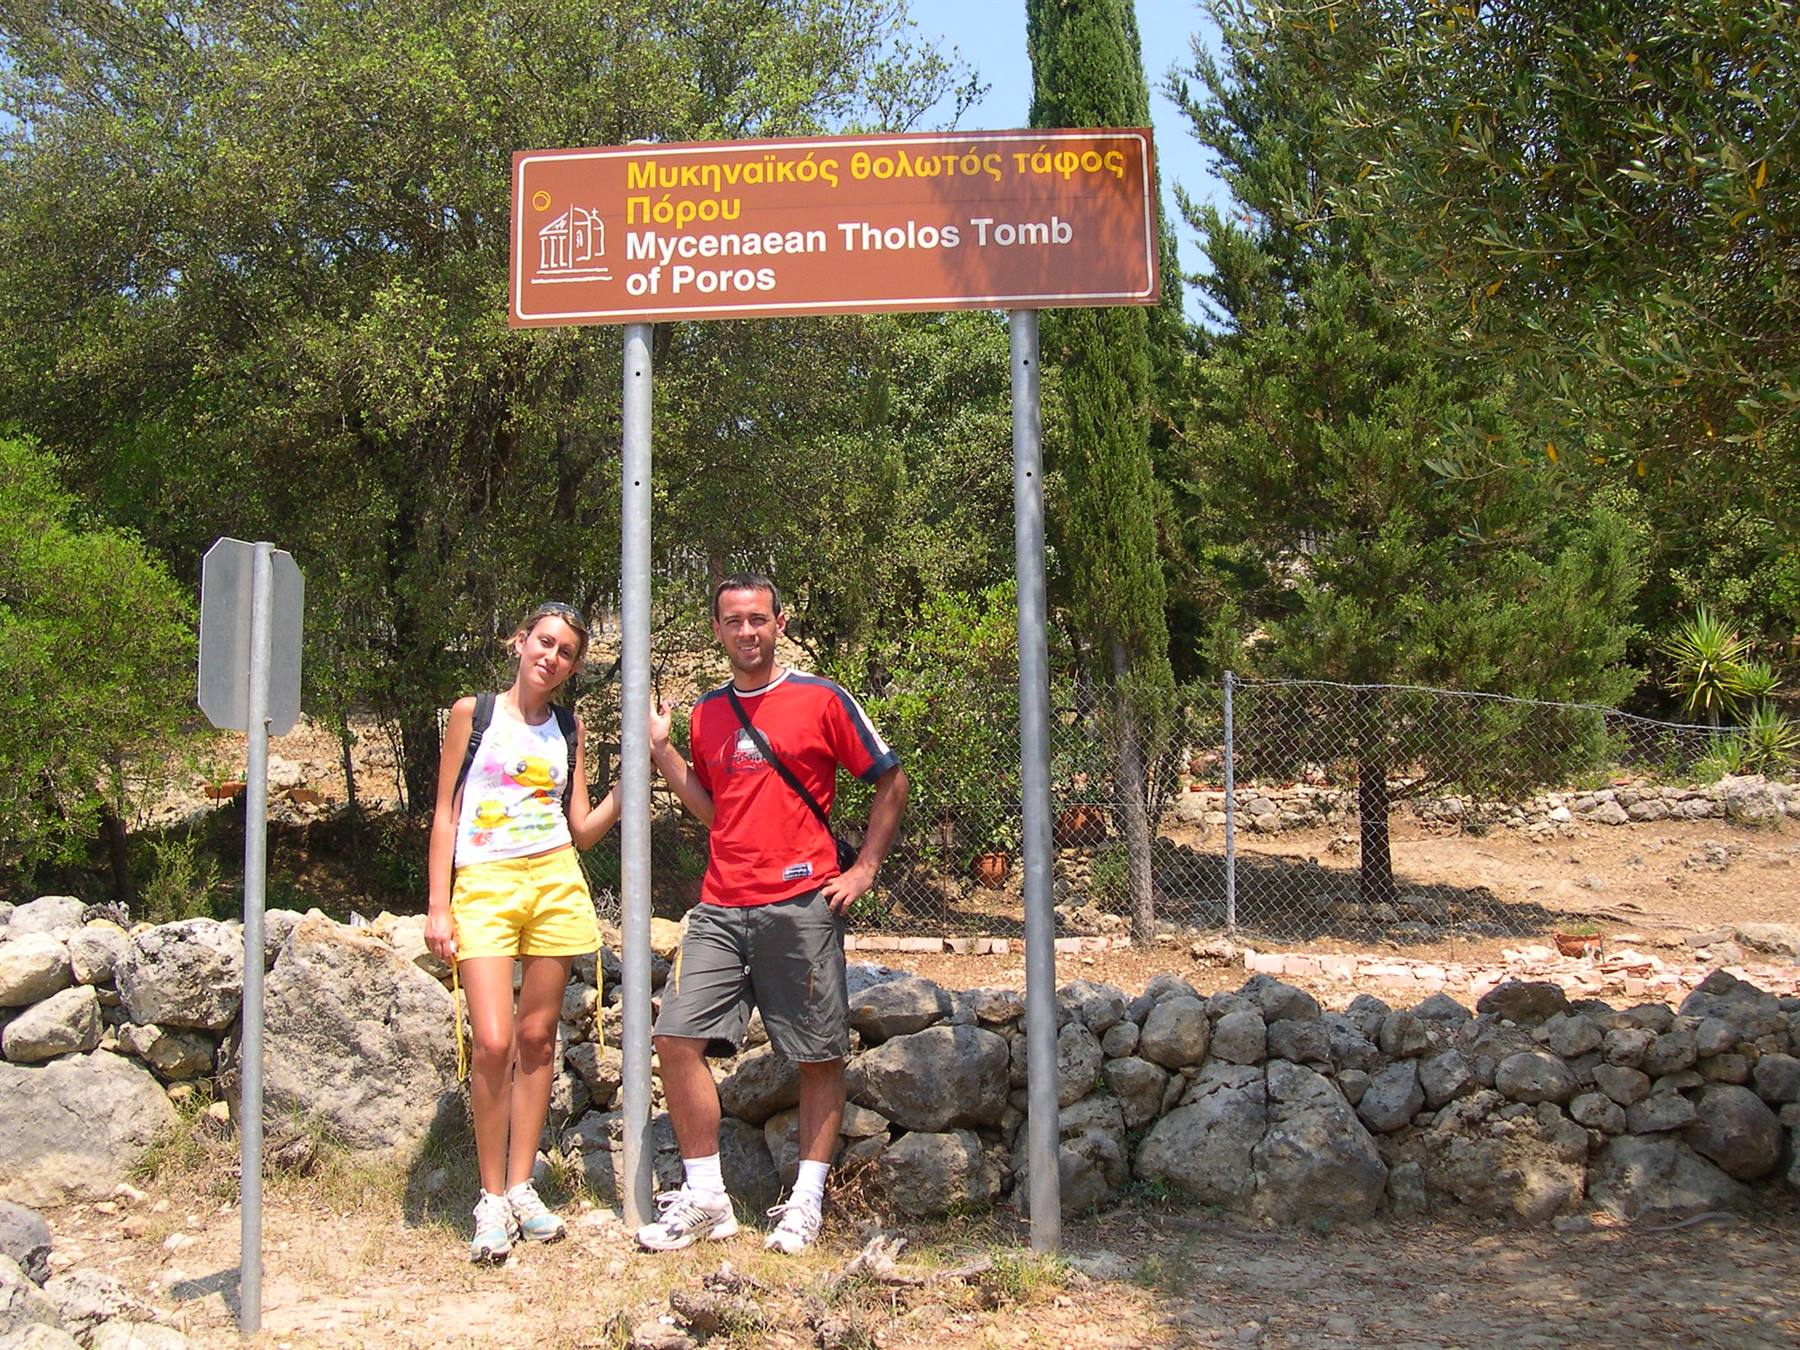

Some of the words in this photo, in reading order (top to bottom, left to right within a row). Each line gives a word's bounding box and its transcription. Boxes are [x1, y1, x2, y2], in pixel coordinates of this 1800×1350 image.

[626, 152, 839, 193] Μυκηναϊκός
[850, 146, 1002, 182] θολωτός
[1012, 144, 1124, 180] τάφος
[626, 194, 742, 230] Πόρου
[626, 229, 827, 266] Mycenaean
[837, 220, 960, 251] Tholos
[970, 216, 1073, 247] Tomb
[625, 266, 661, 296] of
[671, 266, 776, 294] Poros
